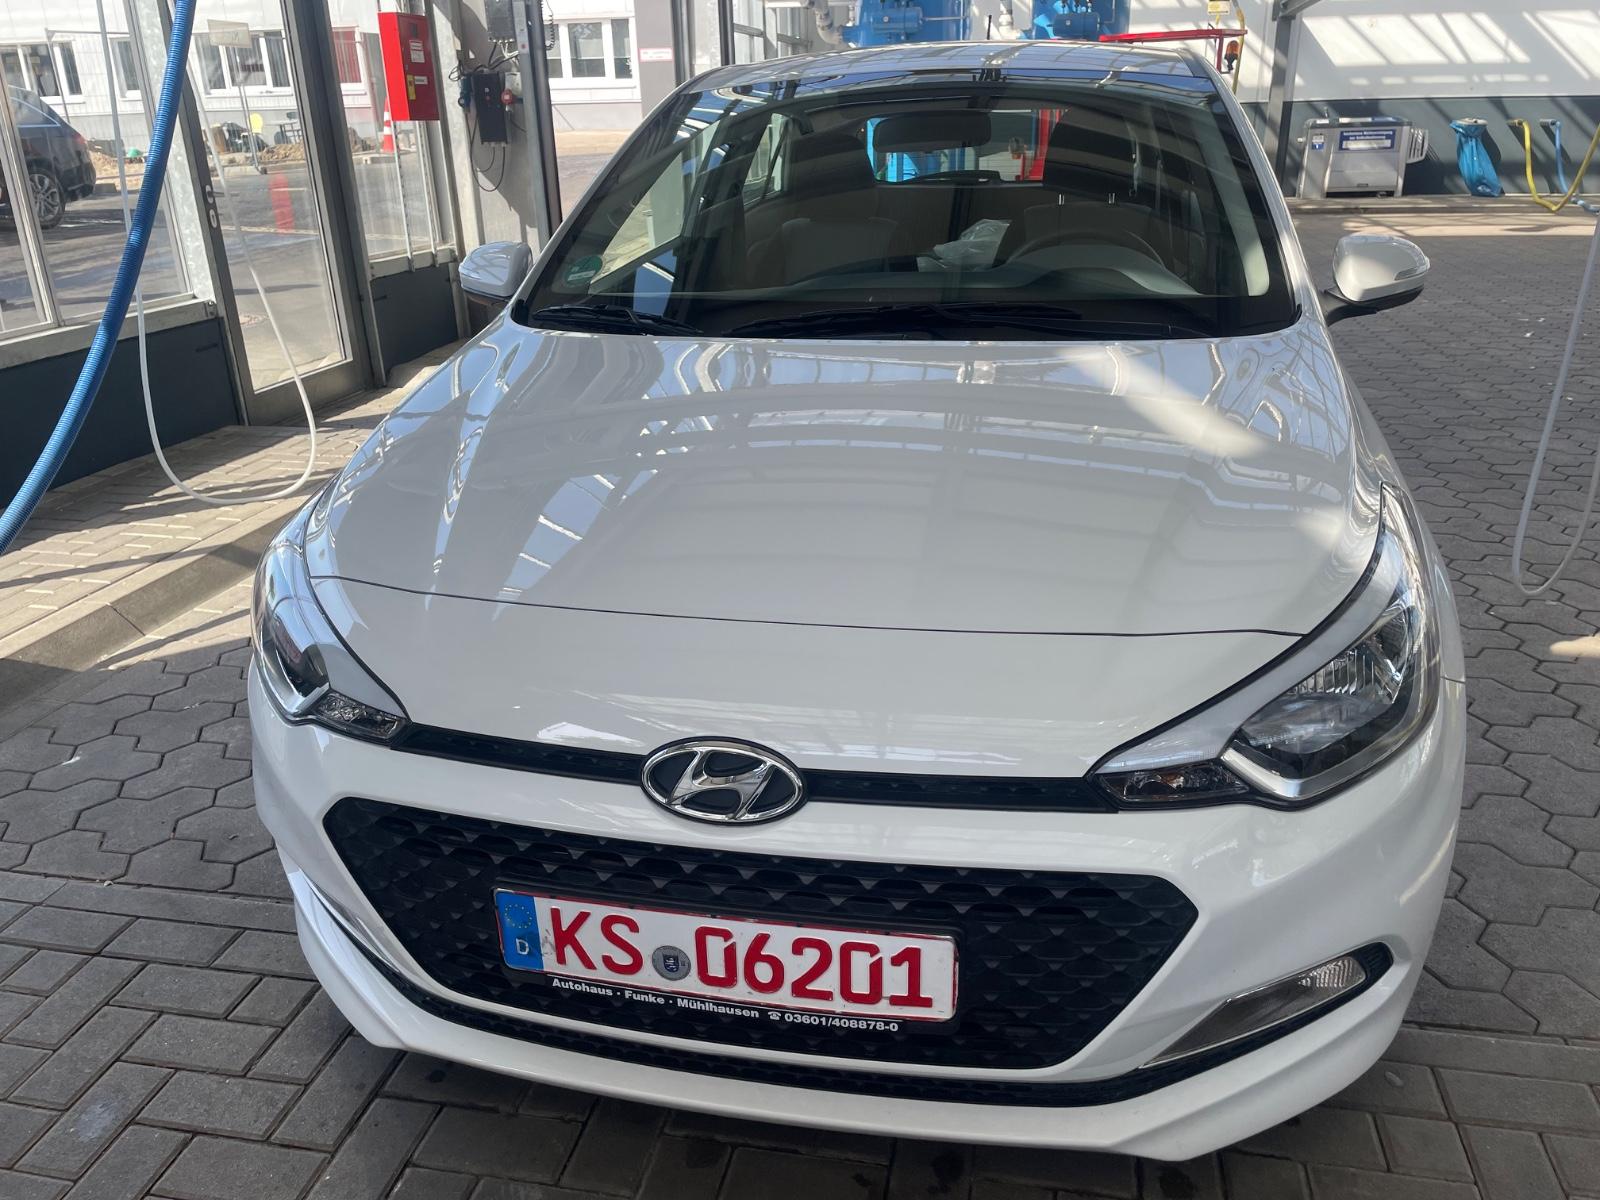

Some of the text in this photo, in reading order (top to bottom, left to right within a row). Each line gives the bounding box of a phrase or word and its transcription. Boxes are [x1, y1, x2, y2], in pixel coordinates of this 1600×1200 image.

[515, 938, 530, 956] D
[549, 905, 933, 1008] KS 06201
[552, 977, 899, 1032] Autohaus Funke Mühlhausen 03601/408878-0
